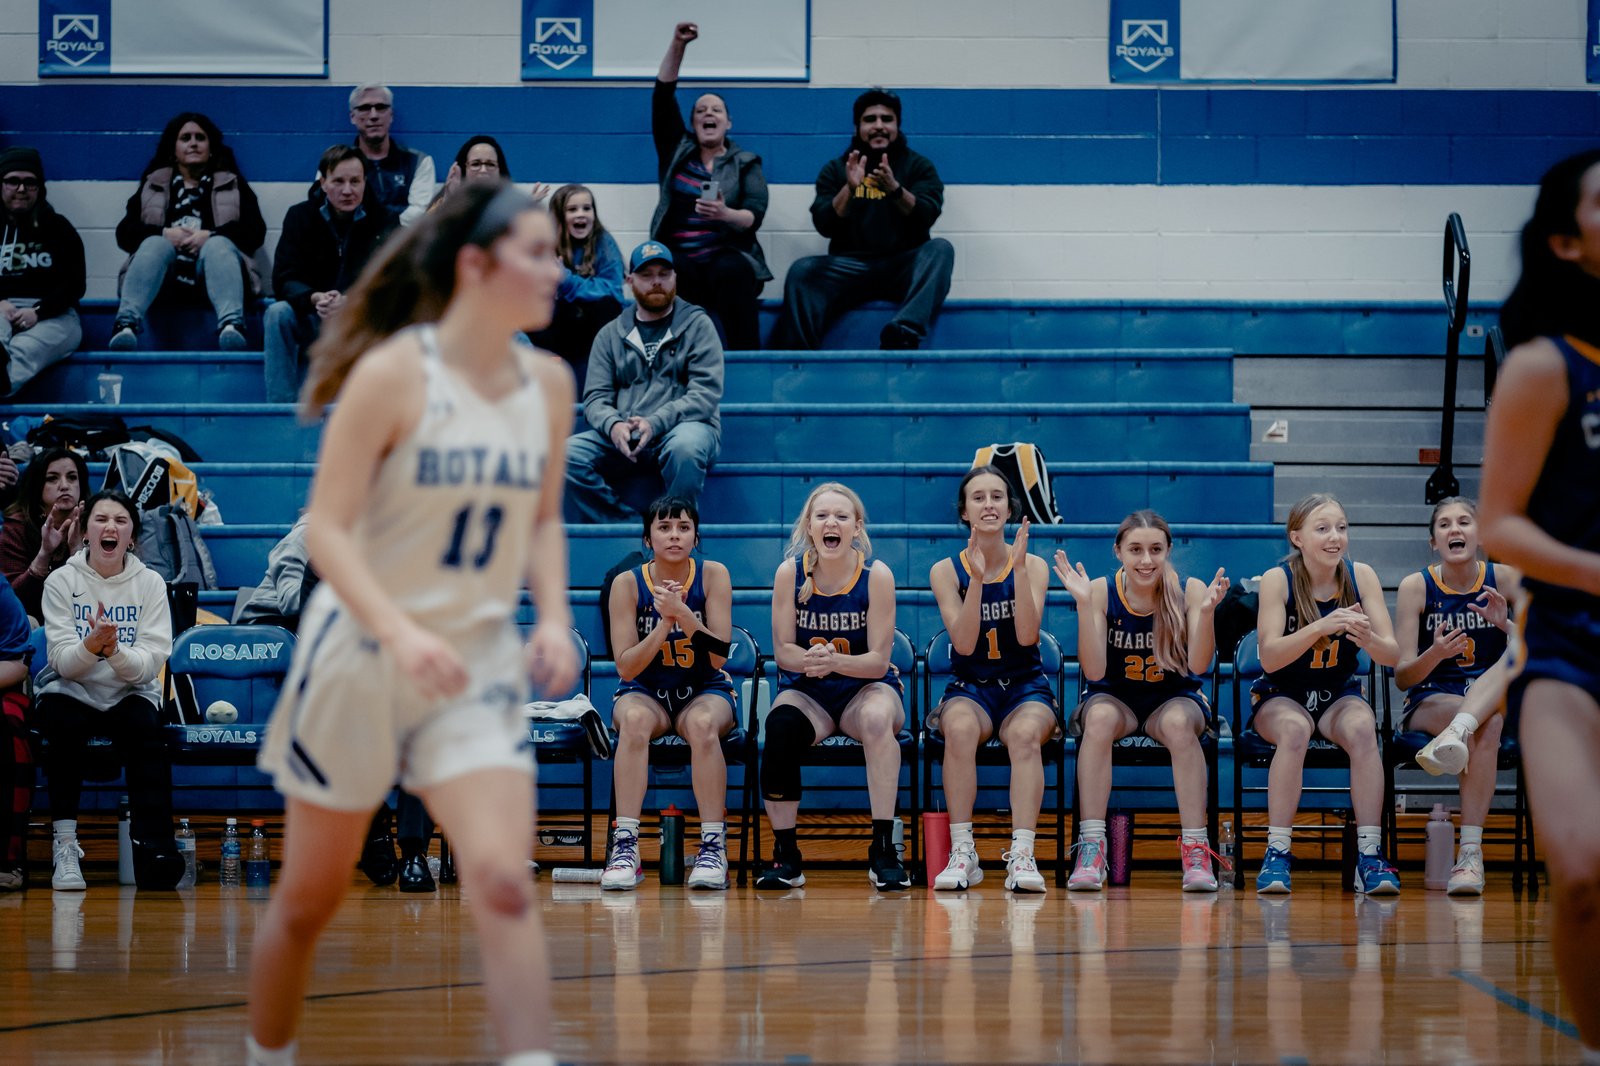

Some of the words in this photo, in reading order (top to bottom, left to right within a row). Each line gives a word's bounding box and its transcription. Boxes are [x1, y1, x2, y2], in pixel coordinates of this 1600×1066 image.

[46, 40, 104, 51] ROYALS
[529, 43, 587, 54] ROYALS
[1116, 45, 1174, 56] ROYALS
[135, 465, 165, 509] BOOMBA
[73, 604, 91, 620] DO
[103, 606, 143, 622] MOR
[1426, 612, 1495, 631] CHARGE
[986, 628, 1001, 659] 1
[1108, 628, 1153, 649] CHARG
[190, 642, 284, 660] ROSARY
[660, 638, 694, 668] 15
[1456, 637, 1475, 667] 3
[1125, 655, 1164, 682] 22
[186, 730, 257, 743] ROYALS
